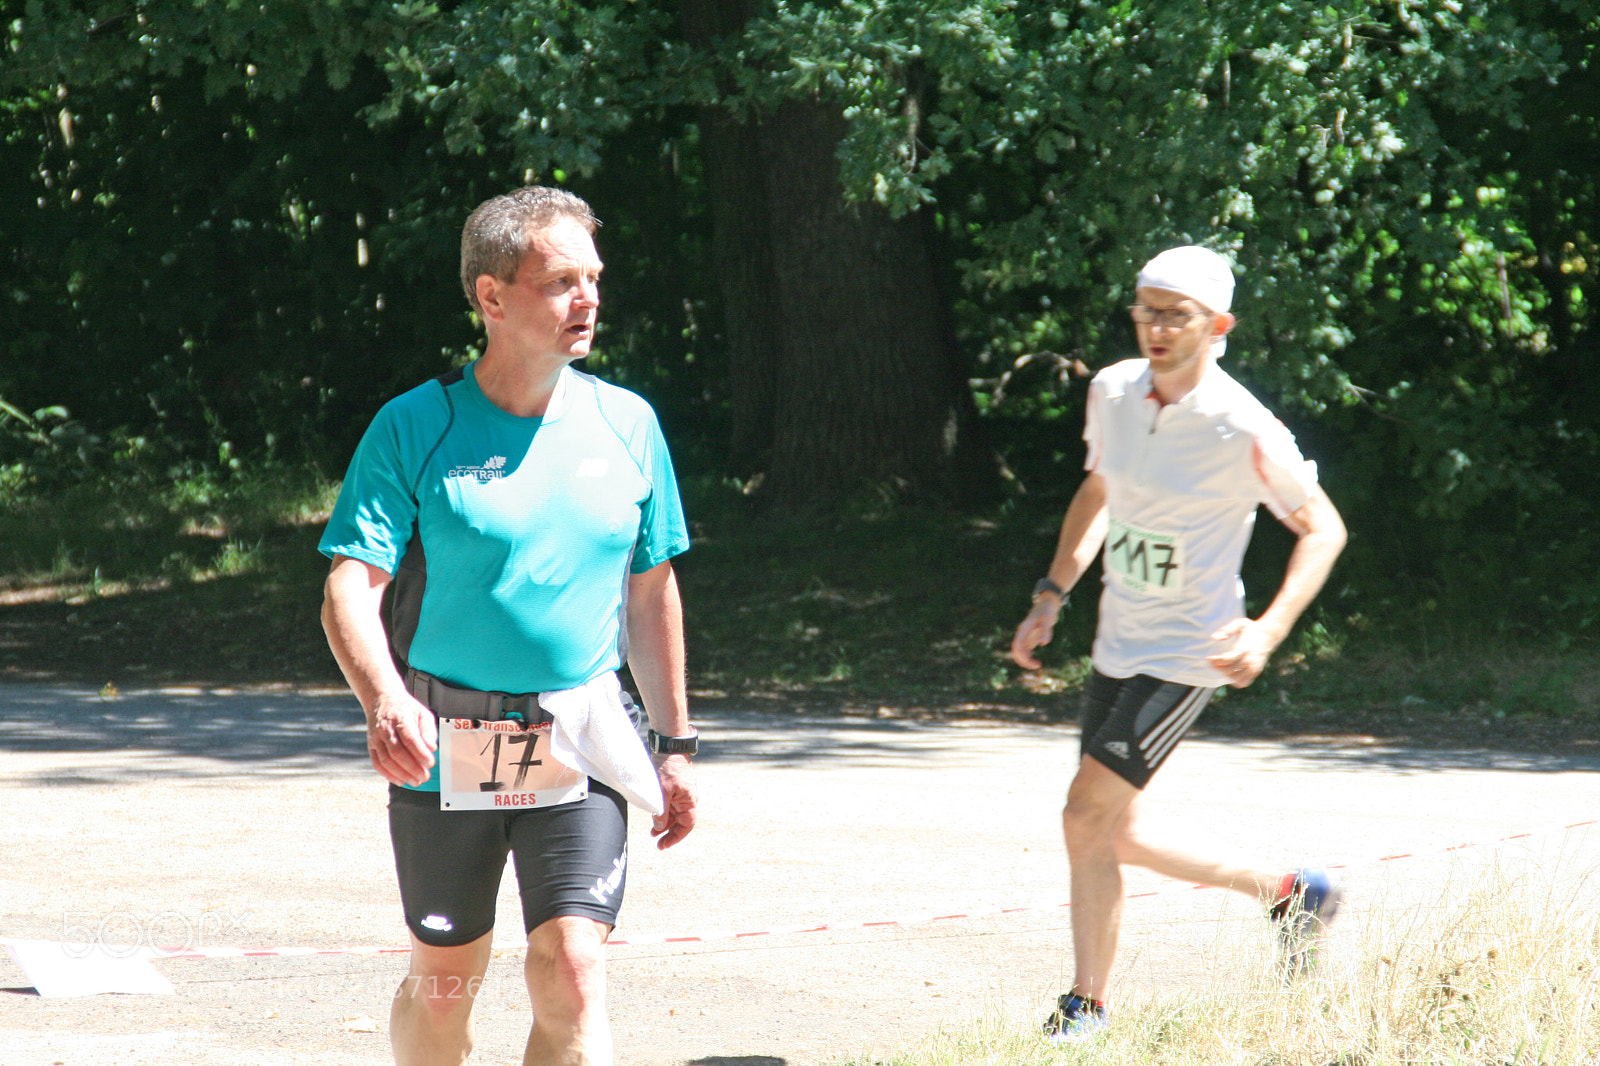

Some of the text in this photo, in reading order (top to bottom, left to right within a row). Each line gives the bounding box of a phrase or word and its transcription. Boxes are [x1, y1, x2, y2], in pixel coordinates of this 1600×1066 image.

[1110, 531, 1178, 587] 117
[480, 733, 543, 792] 17
[494, 793, 536, 806] RACES
